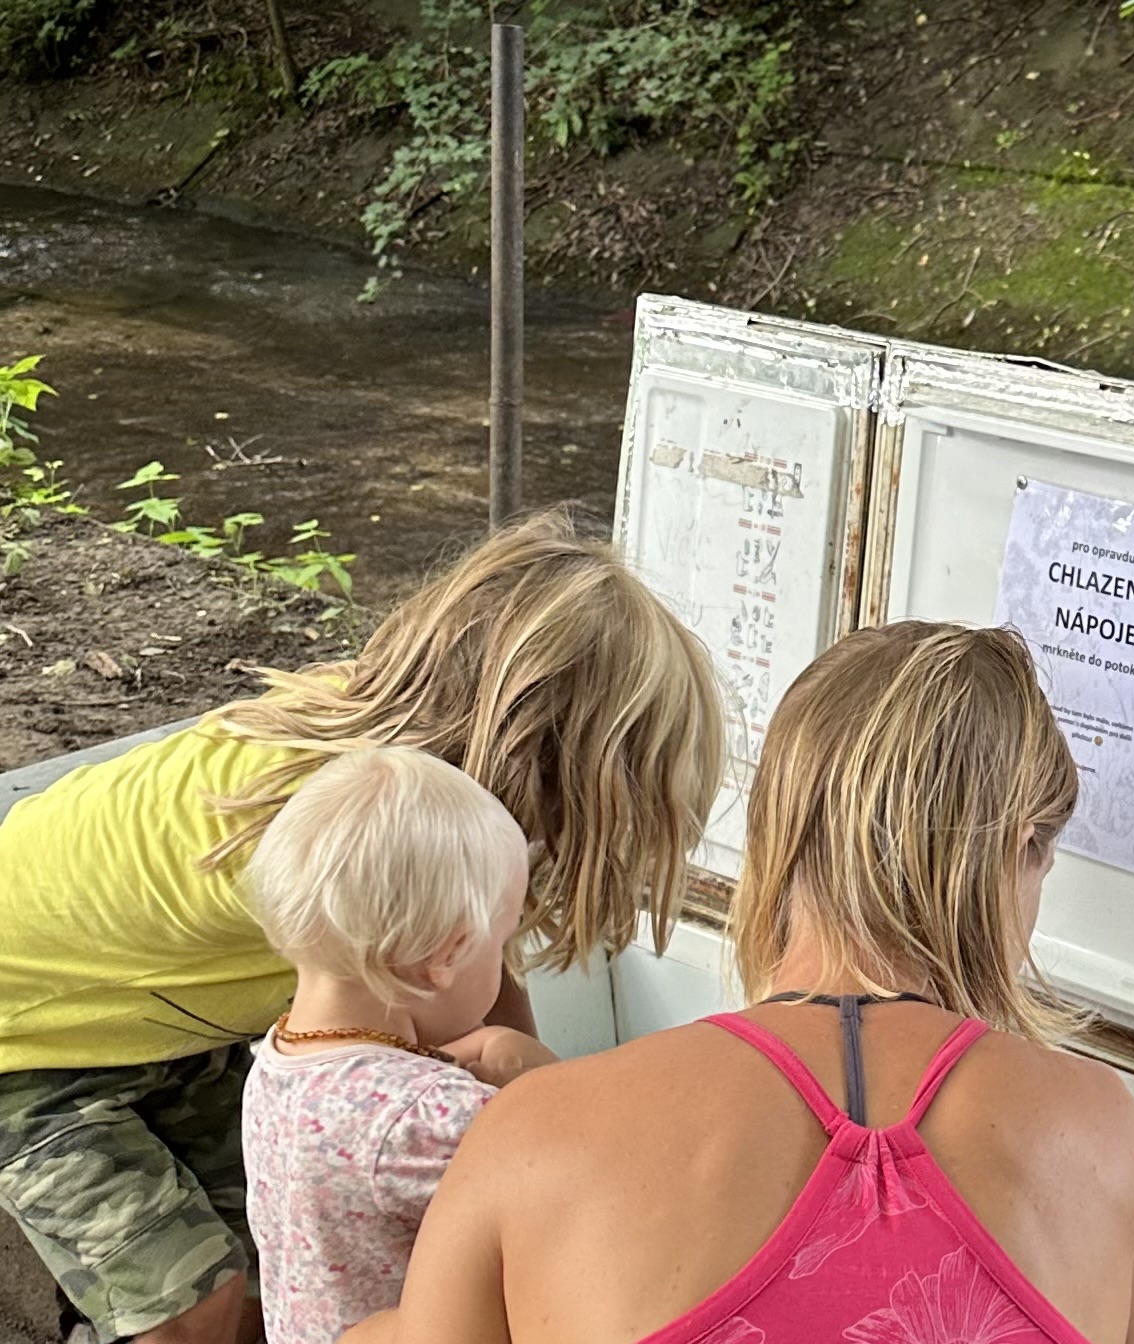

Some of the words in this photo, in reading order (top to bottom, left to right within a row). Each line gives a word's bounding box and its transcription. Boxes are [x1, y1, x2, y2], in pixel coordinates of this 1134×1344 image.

[1072, 541, 1090, 554] pro
[1042, 643, 1086, 663] mrkněte
[1088, 654, 1102, 667] do
